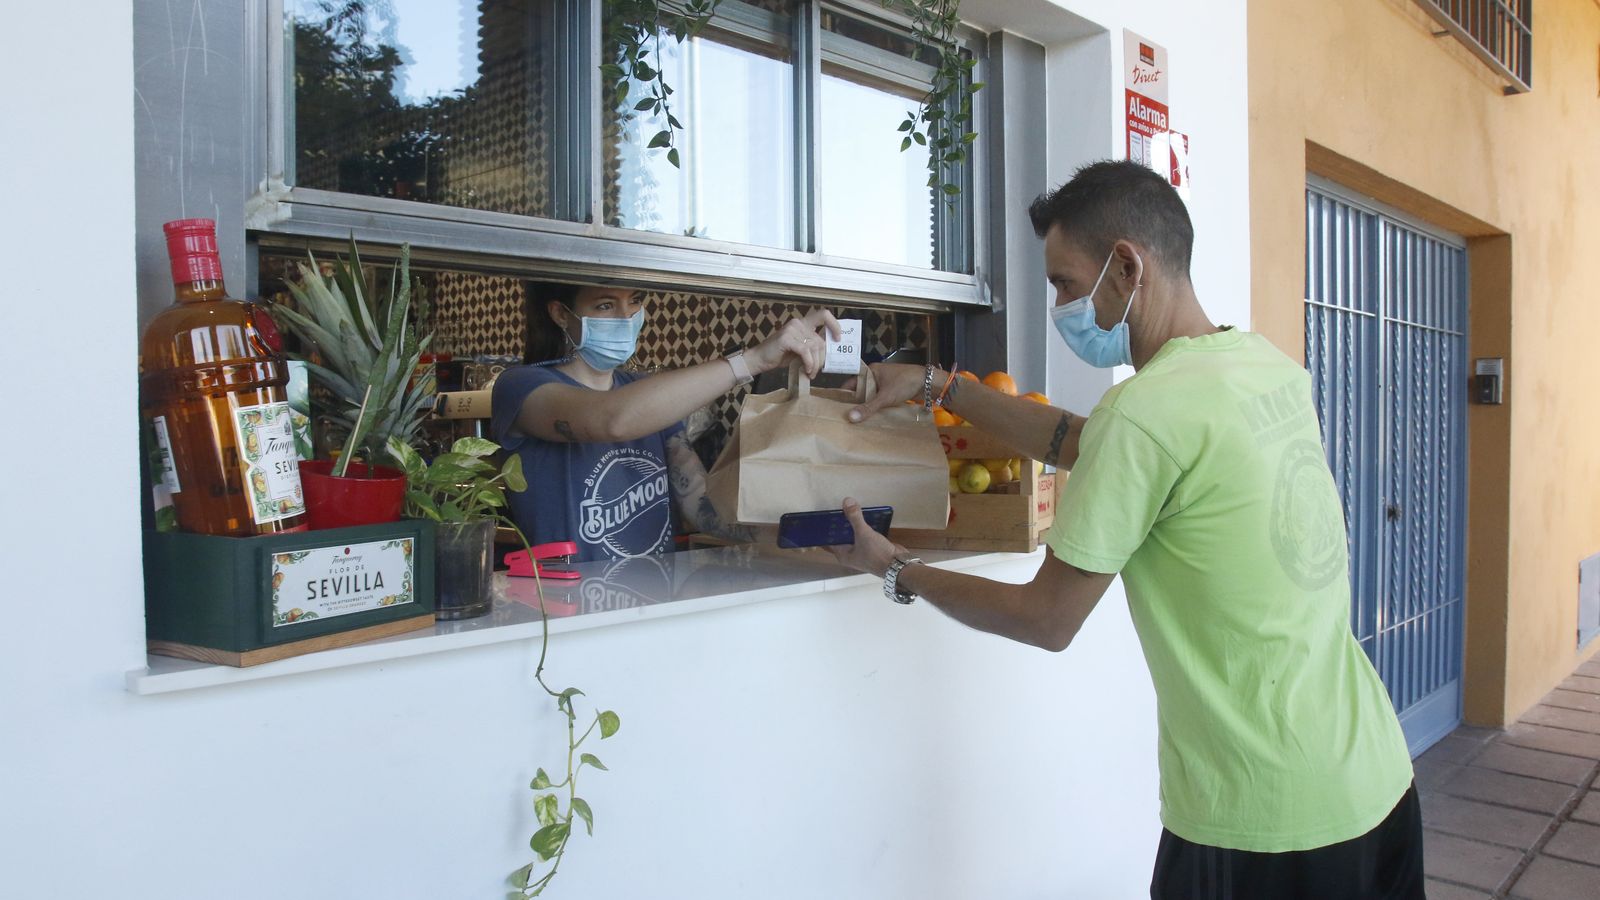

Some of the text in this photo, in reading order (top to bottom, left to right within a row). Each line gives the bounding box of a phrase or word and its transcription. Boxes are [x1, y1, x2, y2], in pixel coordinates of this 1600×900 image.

[1132, 65, 1162, 84] Direct
[1129, 96, 1167, 128] Alarma
[836, 345, 853, 354] 480
[329, 566, 350, 574] FLOR
[307, 571, 384, 600] SEVILLA
